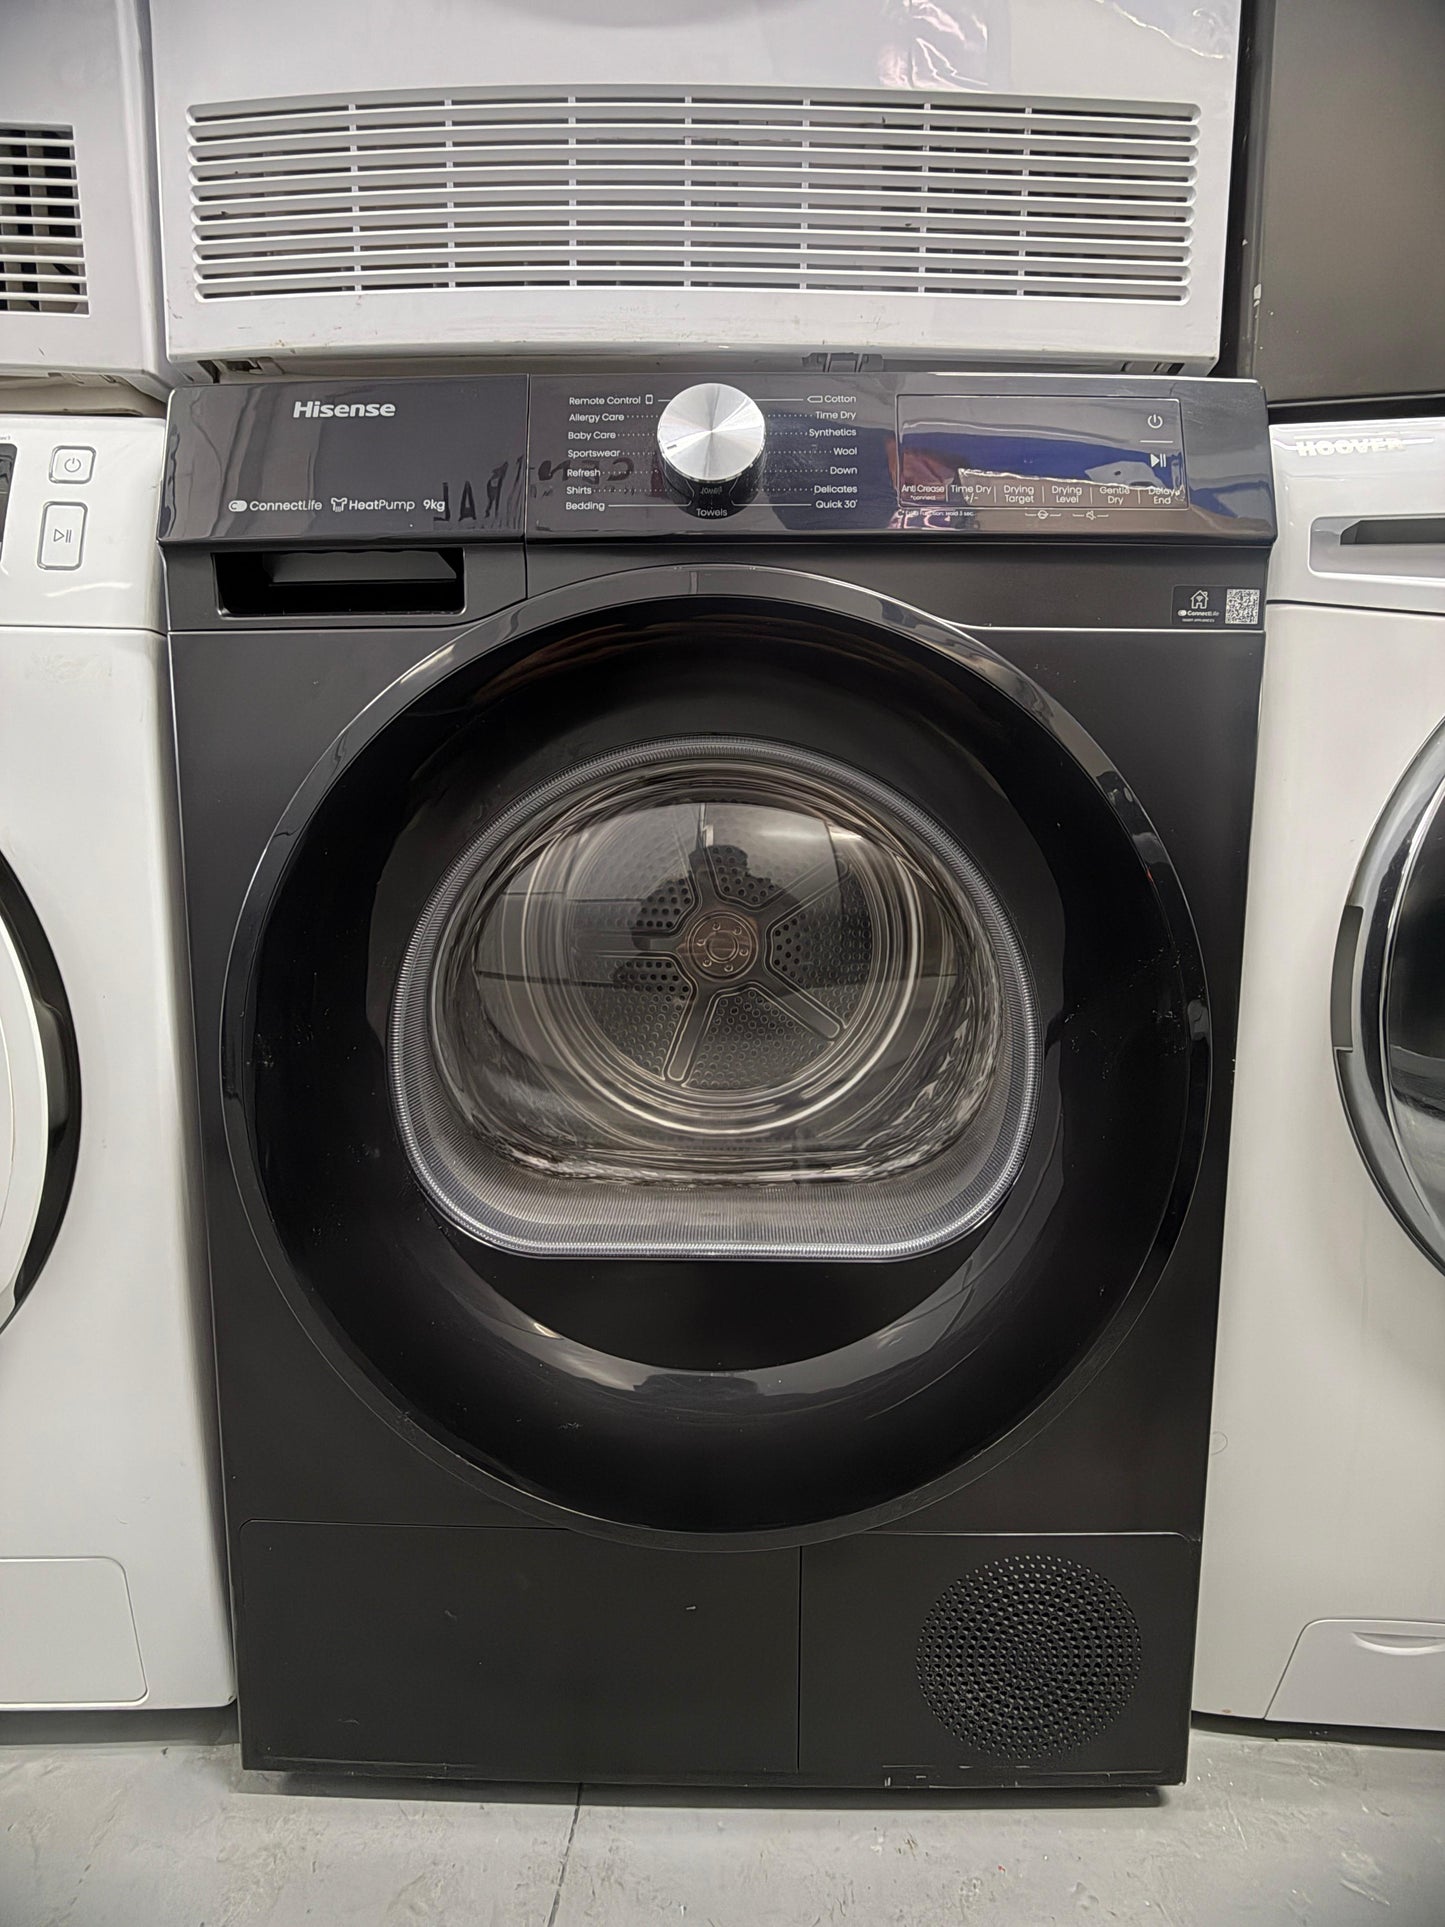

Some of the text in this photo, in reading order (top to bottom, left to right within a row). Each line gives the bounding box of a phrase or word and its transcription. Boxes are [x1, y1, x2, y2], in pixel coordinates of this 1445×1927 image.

[569, 396, 641, 405] Remote Control
[824, 394, 857, 403] Cotton
[293, 401, 396, 418] Hisense
[568, 413, 625, 423] Allergy Care
[815, 410, 857, 421] Time Dry
[568, 431, 617, 441] Baby Care
[809, 428, 857, 438] Synthetics
[567, 449, 621, 459] Sportswear
[833, 446, 858, 456] Wool
[566, 468, 601, 477] Refresh
[830, 466, 858, 475] Down
[566, 486, 592, 495] Shirts
[814, 485, 858, 494] Delicates
[901, 485, 945, 493] Anti Crease
[951, 484, 992, 495] Time Dry
[1003, 485, 1035, 495] Drying
[1051, 485, 1083, 496] Drying
[1099, 486, 1130, 495] Gentle
[1148, 487, 1175, 497] Delay
[1004, 494, 1034, 505] Target
[1056, 494, 1079, 503] Level
[1107, 496, 1124, 505] Dry
[1153, 496, 1172, 505] End
[250, 499, 446, 512] ConnectLife HeatPump 9kg
[565, 502, 606, 512] Bedding
[815, 500, 842, 508] Quick
[696, 509, 728, 517] Towels
